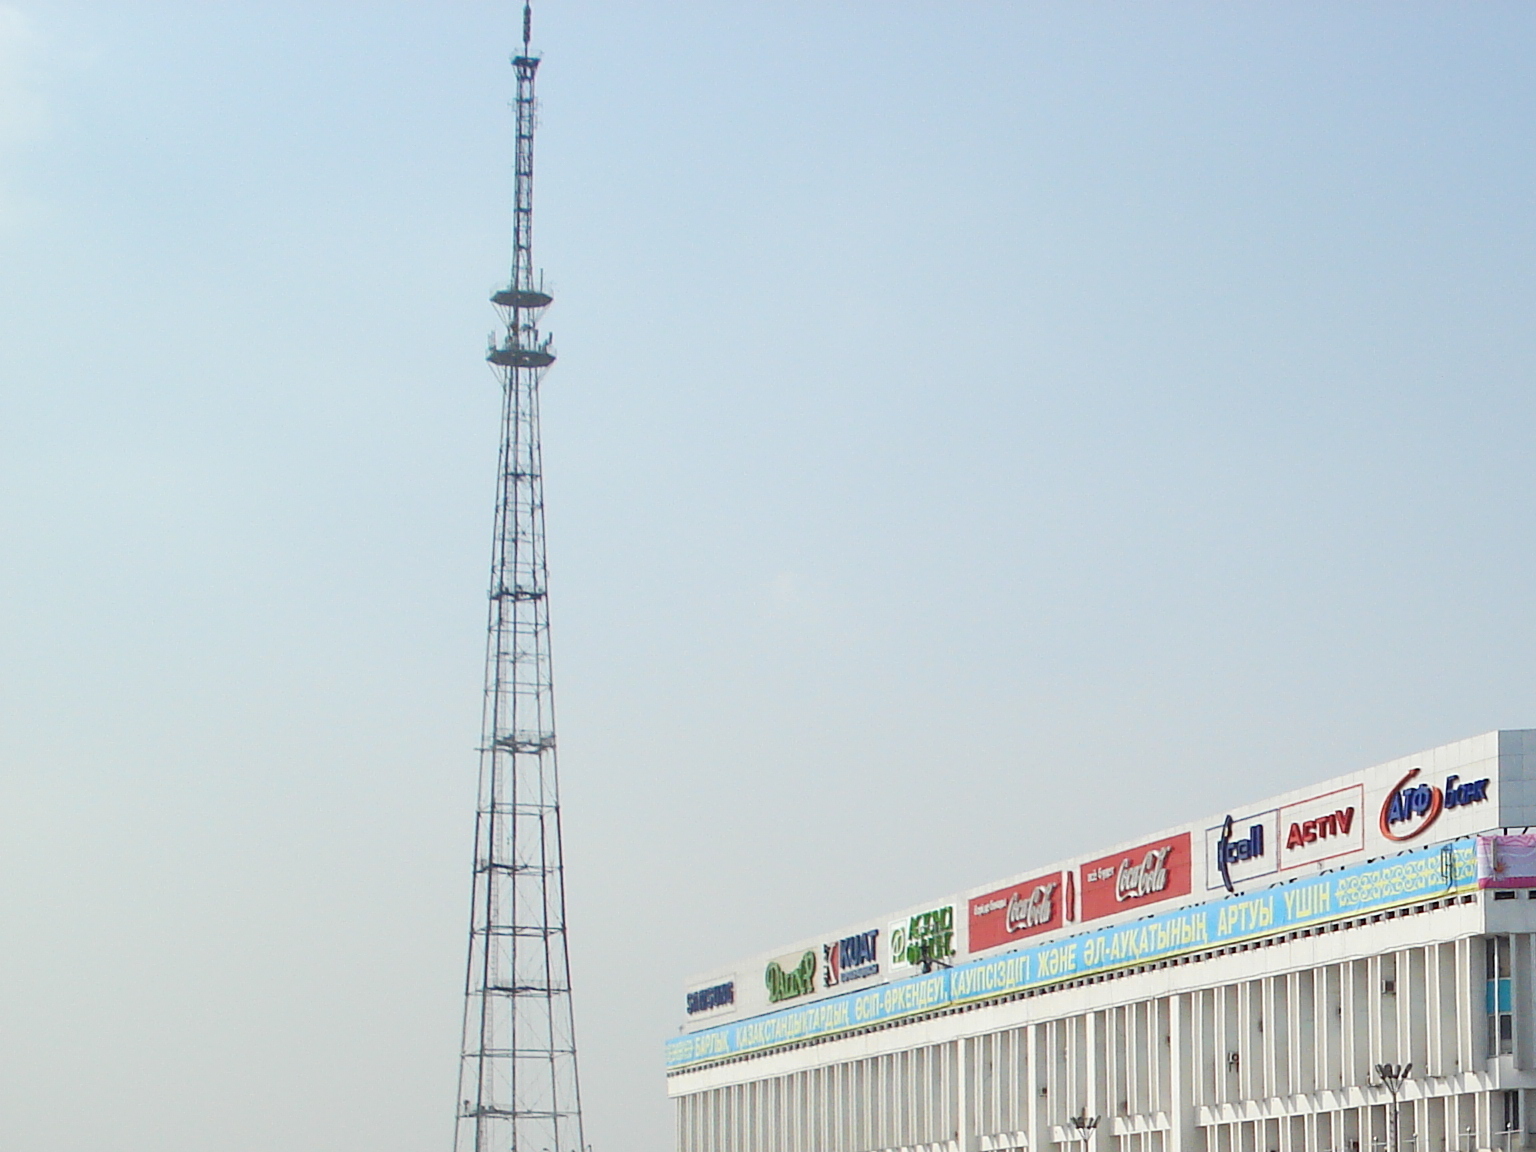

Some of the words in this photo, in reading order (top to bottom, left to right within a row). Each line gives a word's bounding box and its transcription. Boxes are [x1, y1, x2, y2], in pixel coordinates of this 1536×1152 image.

[1388, 784, 1432, 824] АТФ
[840, 929, 879, 969] KUAT
[951, 955, 1030, 997] ҚАУІПСІЗДІГІ
[1037, 943, 1077, 978] ЖӘНЕ
[1084, 912, 1208, 966] ӘЛ-АУҚАТЫНЫҢ
[1217, 895, 1274, 937] АРТУЫ
[1284, 882, 1330, 920] ҮШІН
